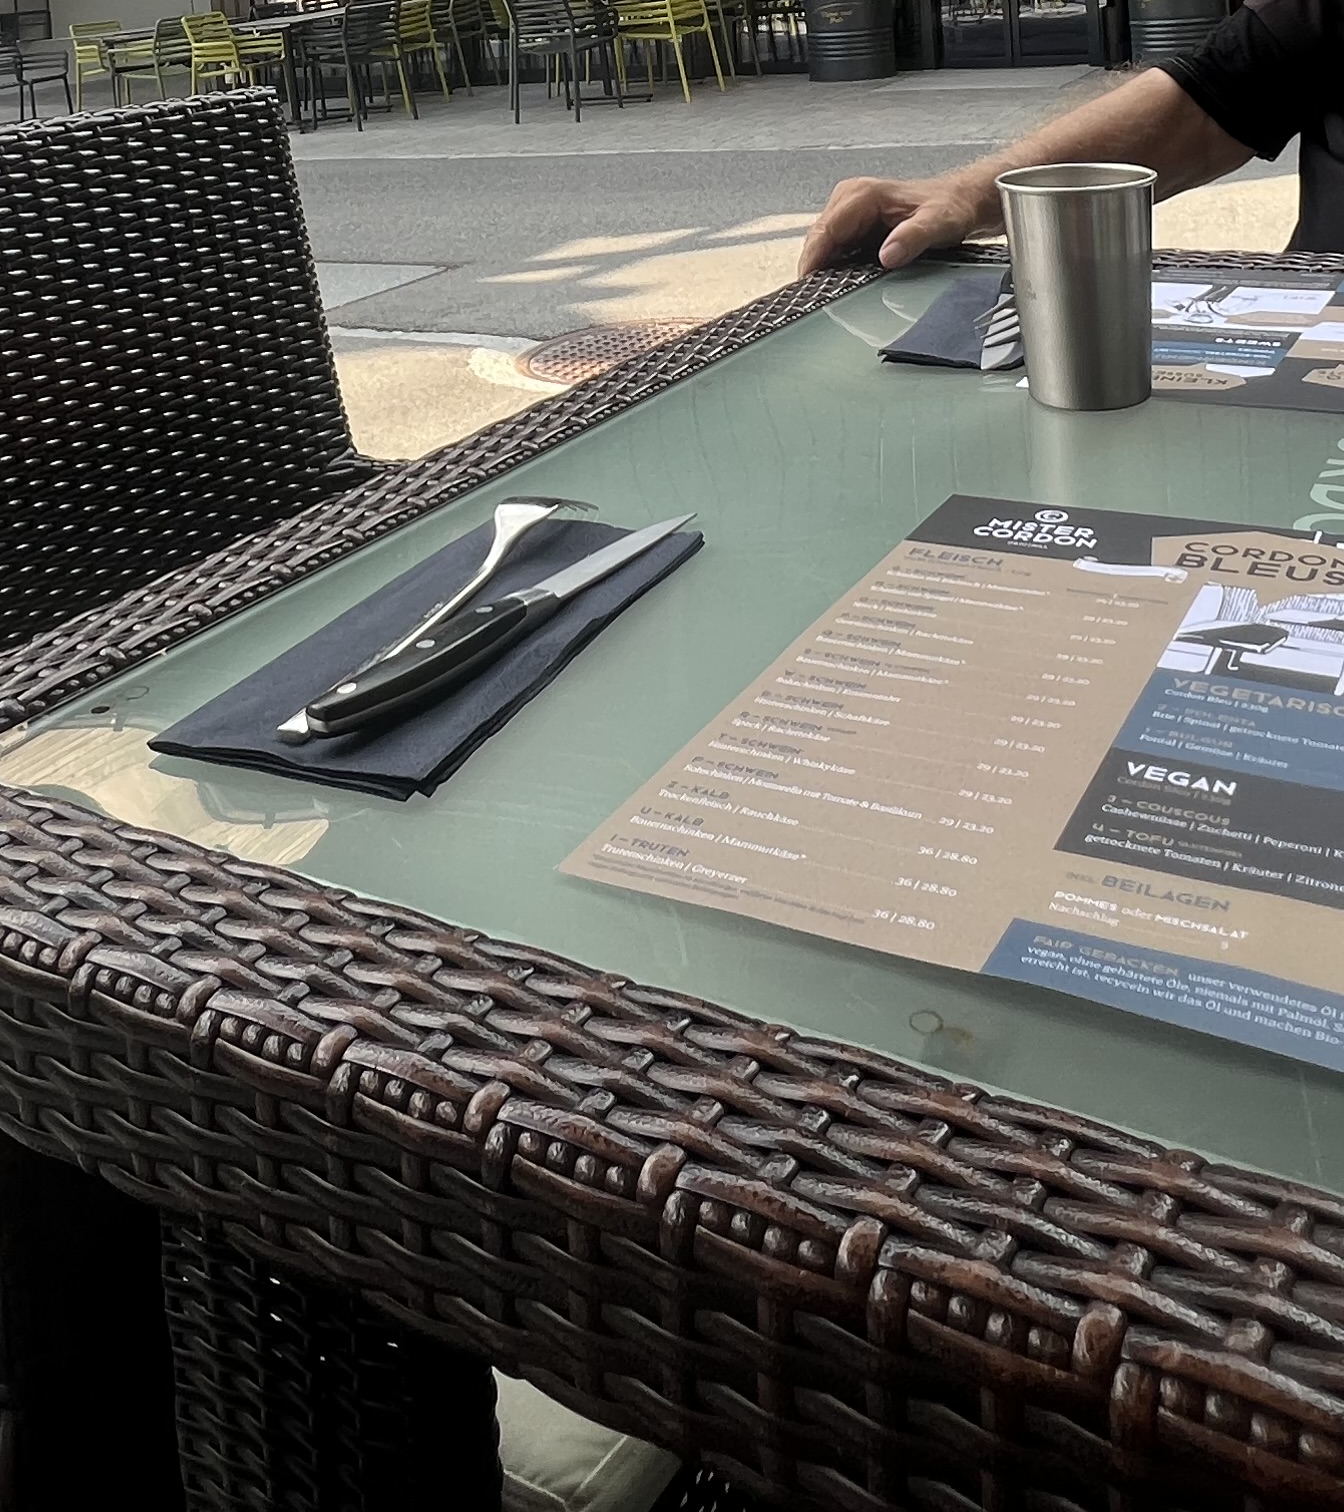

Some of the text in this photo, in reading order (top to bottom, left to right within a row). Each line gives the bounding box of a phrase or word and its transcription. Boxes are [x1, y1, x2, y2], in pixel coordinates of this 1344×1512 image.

[973, 525, 1097, 549] CORDON
[987, 517, 1094, 539] MISTER
[908, 547, 1004, 567] FLEISCH
[1127, 761, 1237, 796] VEGAN
[630, 837, 690, 858] TRUTEN
[1125, 828, 1175, 847] TOFU
[916, 845, 934, 856] 36
[941, 850, 978, 865] 28.80
[1163, 847, 1222, 869] Tomaten
[893, 876, 913, 887] 36
[920, 882, 958, 897] 28.80
[1101, 874, 1230, 912] BEILAGEN
[1053, 890, 1118, 912] POMMES
[871, 908, 890, 920] 36
[897, 914, 936, 931] 28.80
[1187, 972, 1226, 988] unser
[1152, 988, 1176, 1001] wir
[1176, 993, 1203, 1008] das
[1222, 1007, 1252, 1021] und
[1253, 1014, 1312, 1038] machen
[1250, 1000, 1275, 1014] mit
